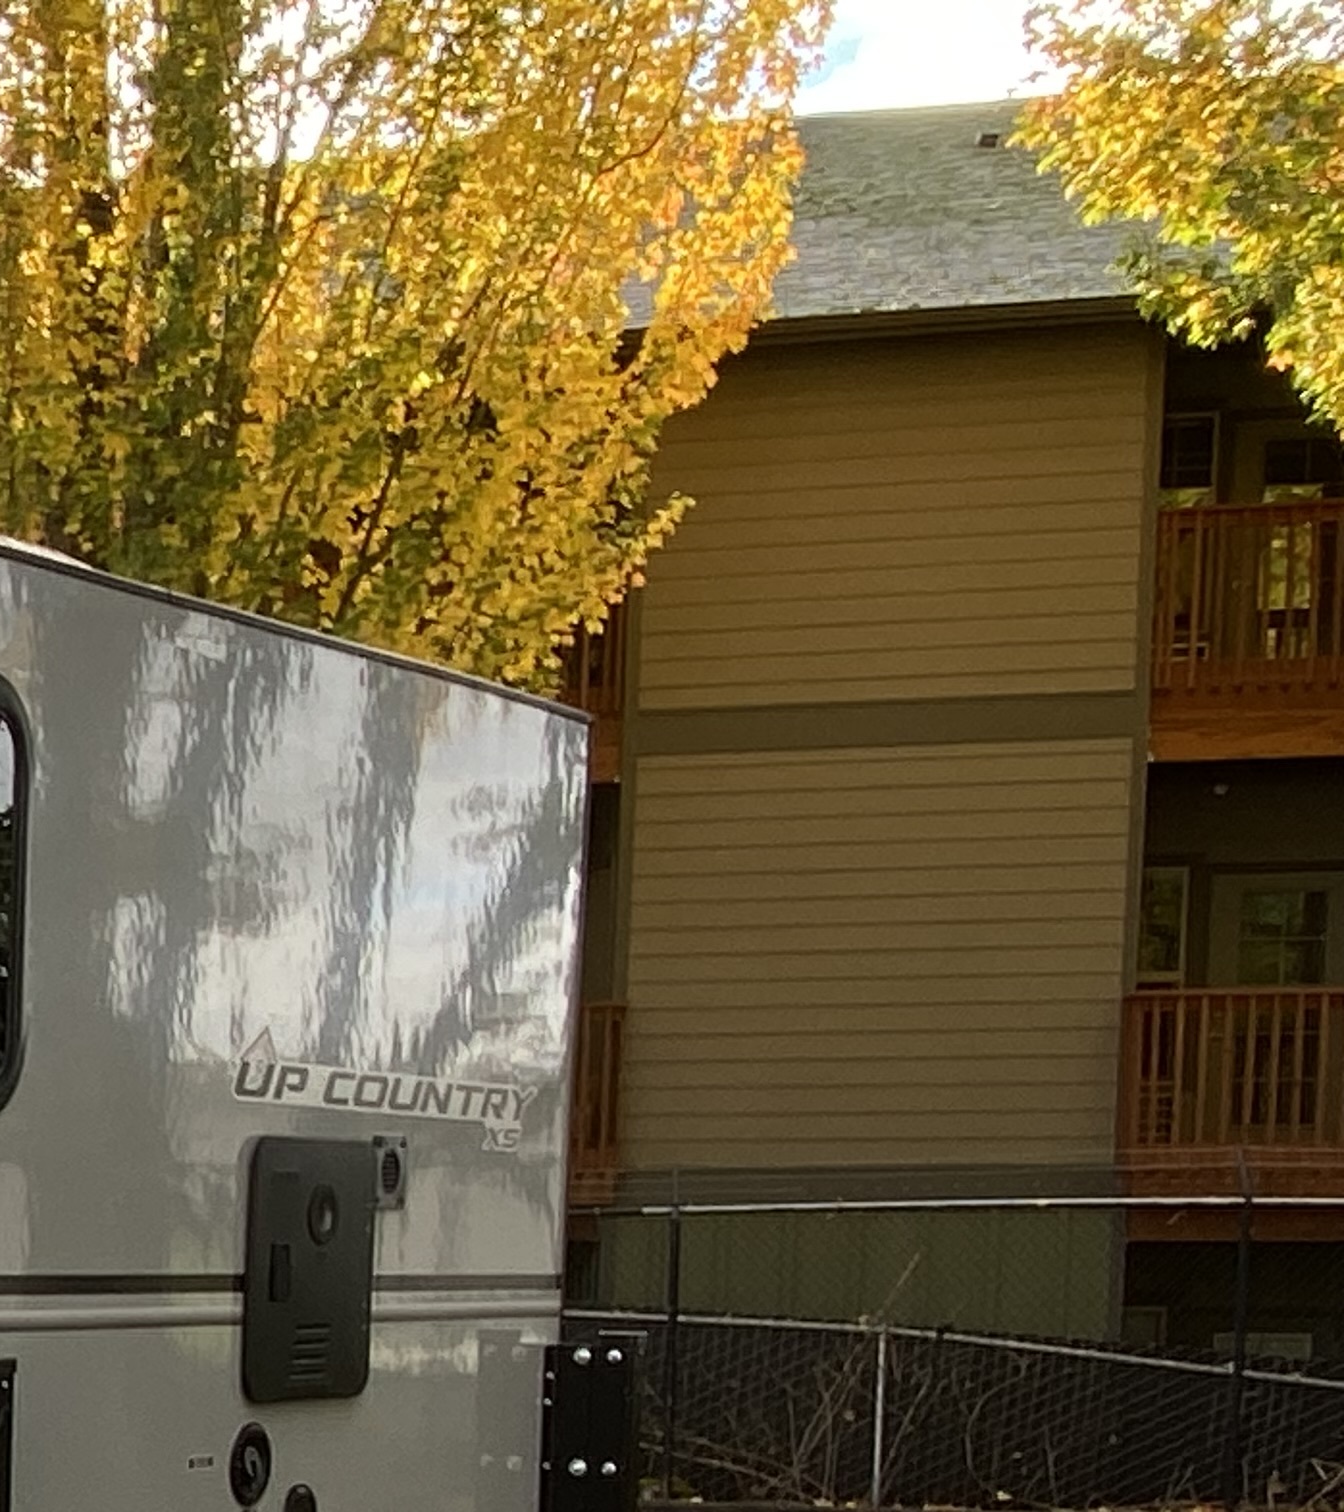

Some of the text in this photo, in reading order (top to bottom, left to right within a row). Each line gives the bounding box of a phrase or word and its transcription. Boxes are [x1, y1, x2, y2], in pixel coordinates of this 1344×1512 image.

[233, 1060, 538, 1122] UP COUNTRY
[481, 1126, 523, 1152] XS
